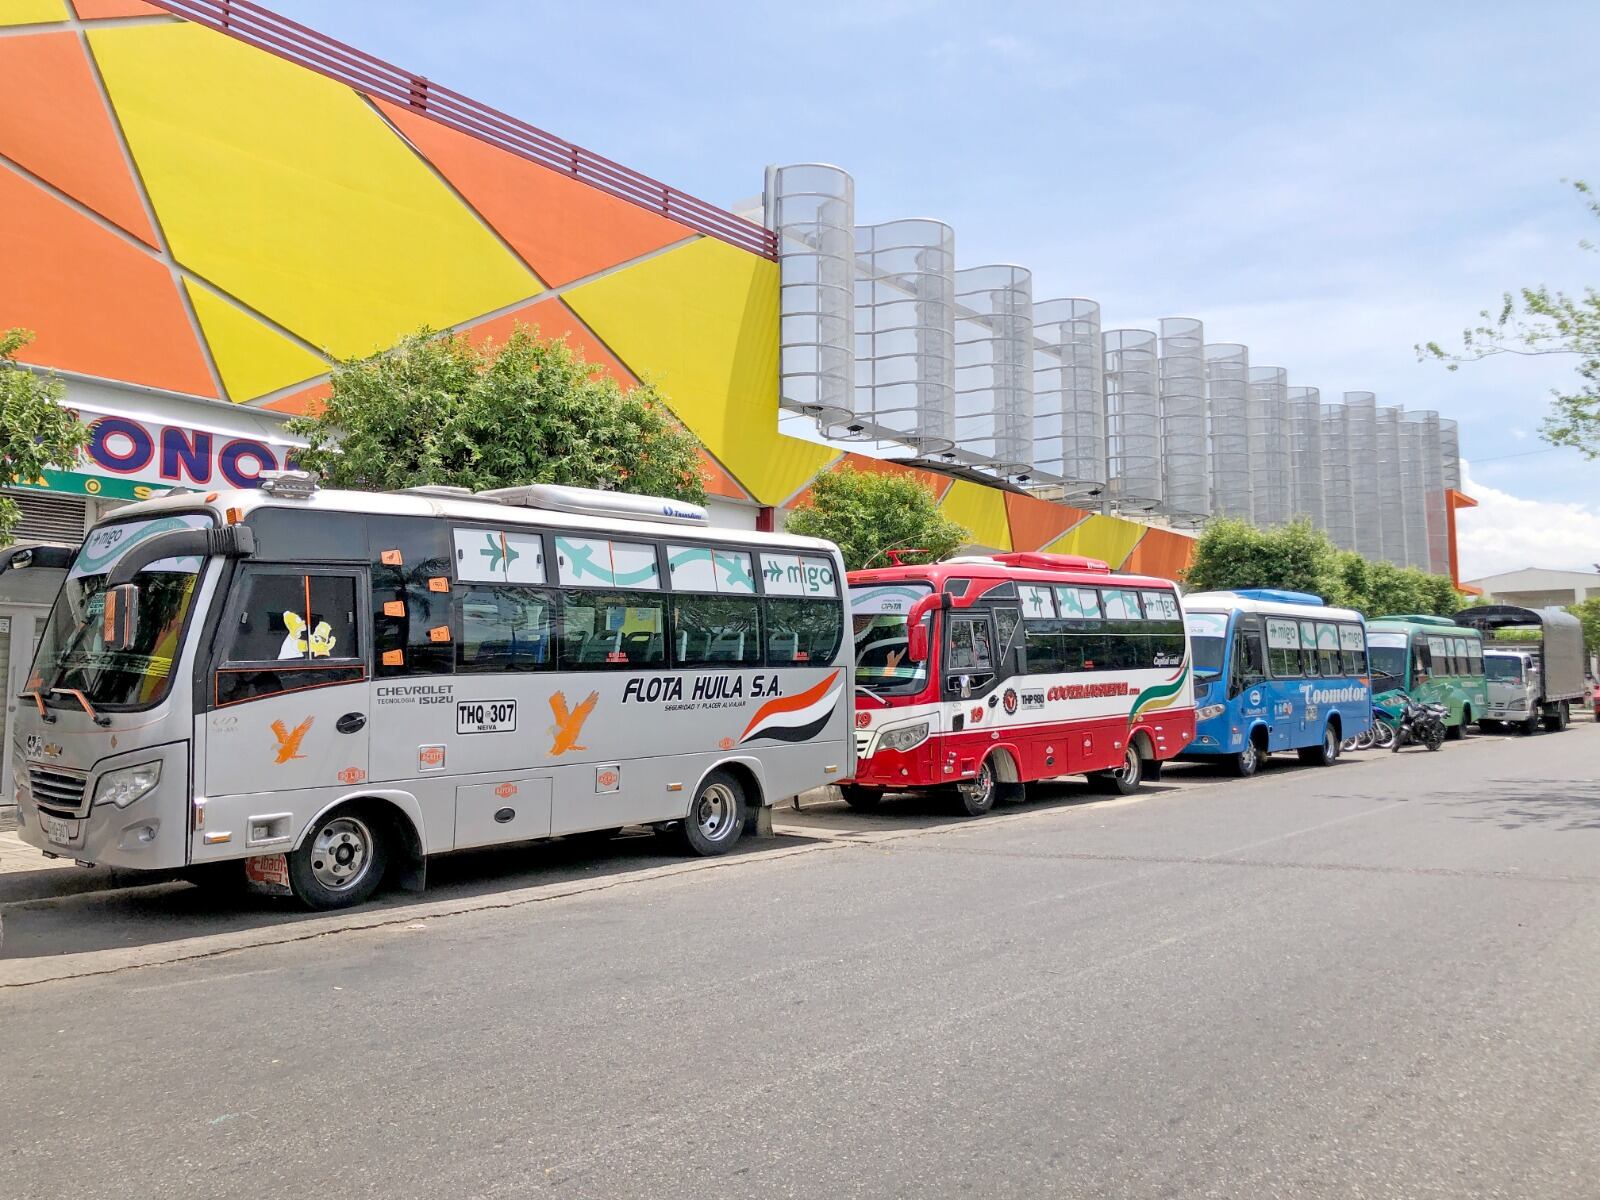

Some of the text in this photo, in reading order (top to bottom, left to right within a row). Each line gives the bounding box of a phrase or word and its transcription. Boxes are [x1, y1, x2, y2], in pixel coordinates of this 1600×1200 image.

[66, 408, 301, 490] ONO
[787, 561, 833, 592] migo
[1156, 600, 1177, 617] mgo
[377, 685, 454, 697] CHEVROLET
[622, 675, 783, 703] FLOTA HUILA S.A.
[1299, 683, 1367, 705] Coomotor
[419, 695, 454, 705] ISUZU
[664, 703, 695, 711] SEGURIDAD
[1021, 692, 1045, 705] THP 980
[459, 704, 515, 725] THQ 307
[855, 711, 872, 729] 19
[970, 706, 984, 724] 19
